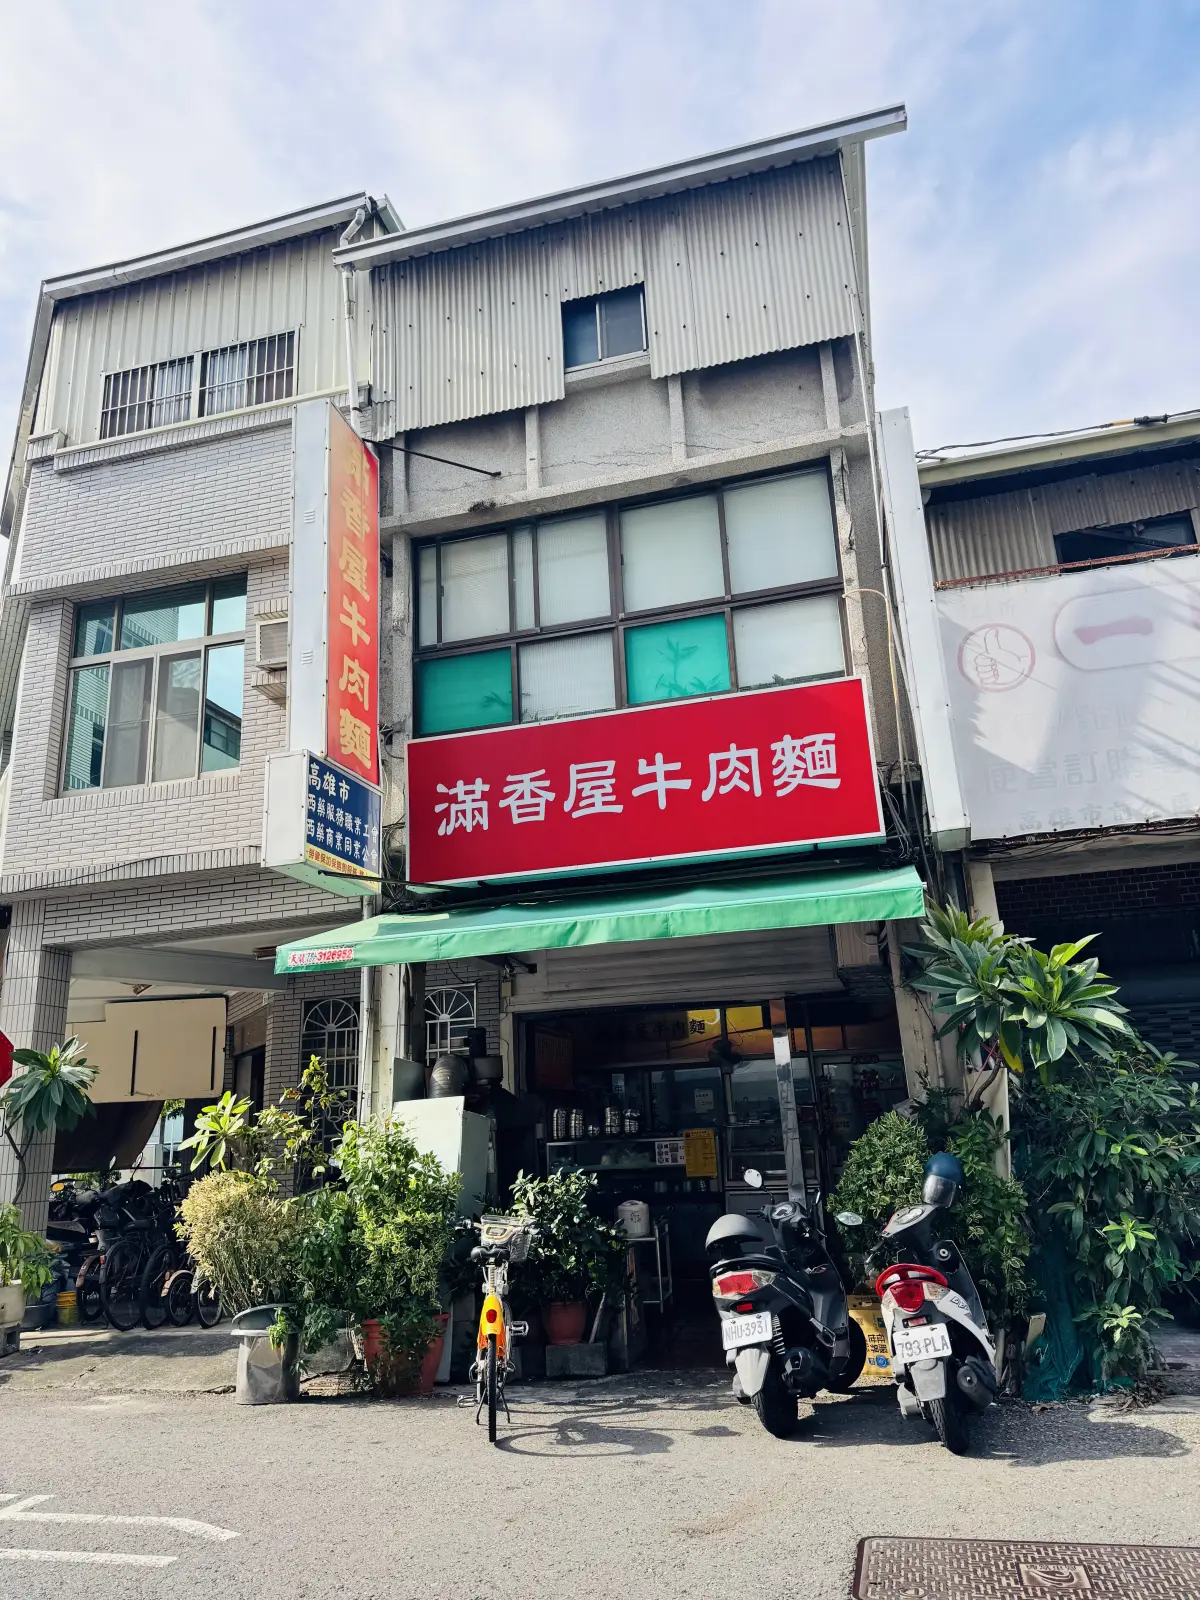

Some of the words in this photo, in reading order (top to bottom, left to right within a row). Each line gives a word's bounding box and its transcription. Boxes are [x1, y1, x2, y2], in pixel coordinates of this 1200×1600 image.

[308, 762, 351, 804] 高雄市
[434, 732, 841, 836] 滿香屋牛肉麵
[307, 793, 379, 844] 西藥服務職業工會
[306, 818, 379, 867] 西藥商業同業公會
[317, 948, 353, 962] 3126952
[725, 1320, 768, 1342] NHU-3931
[896, 1334, 951, 1359] 793-PLA
